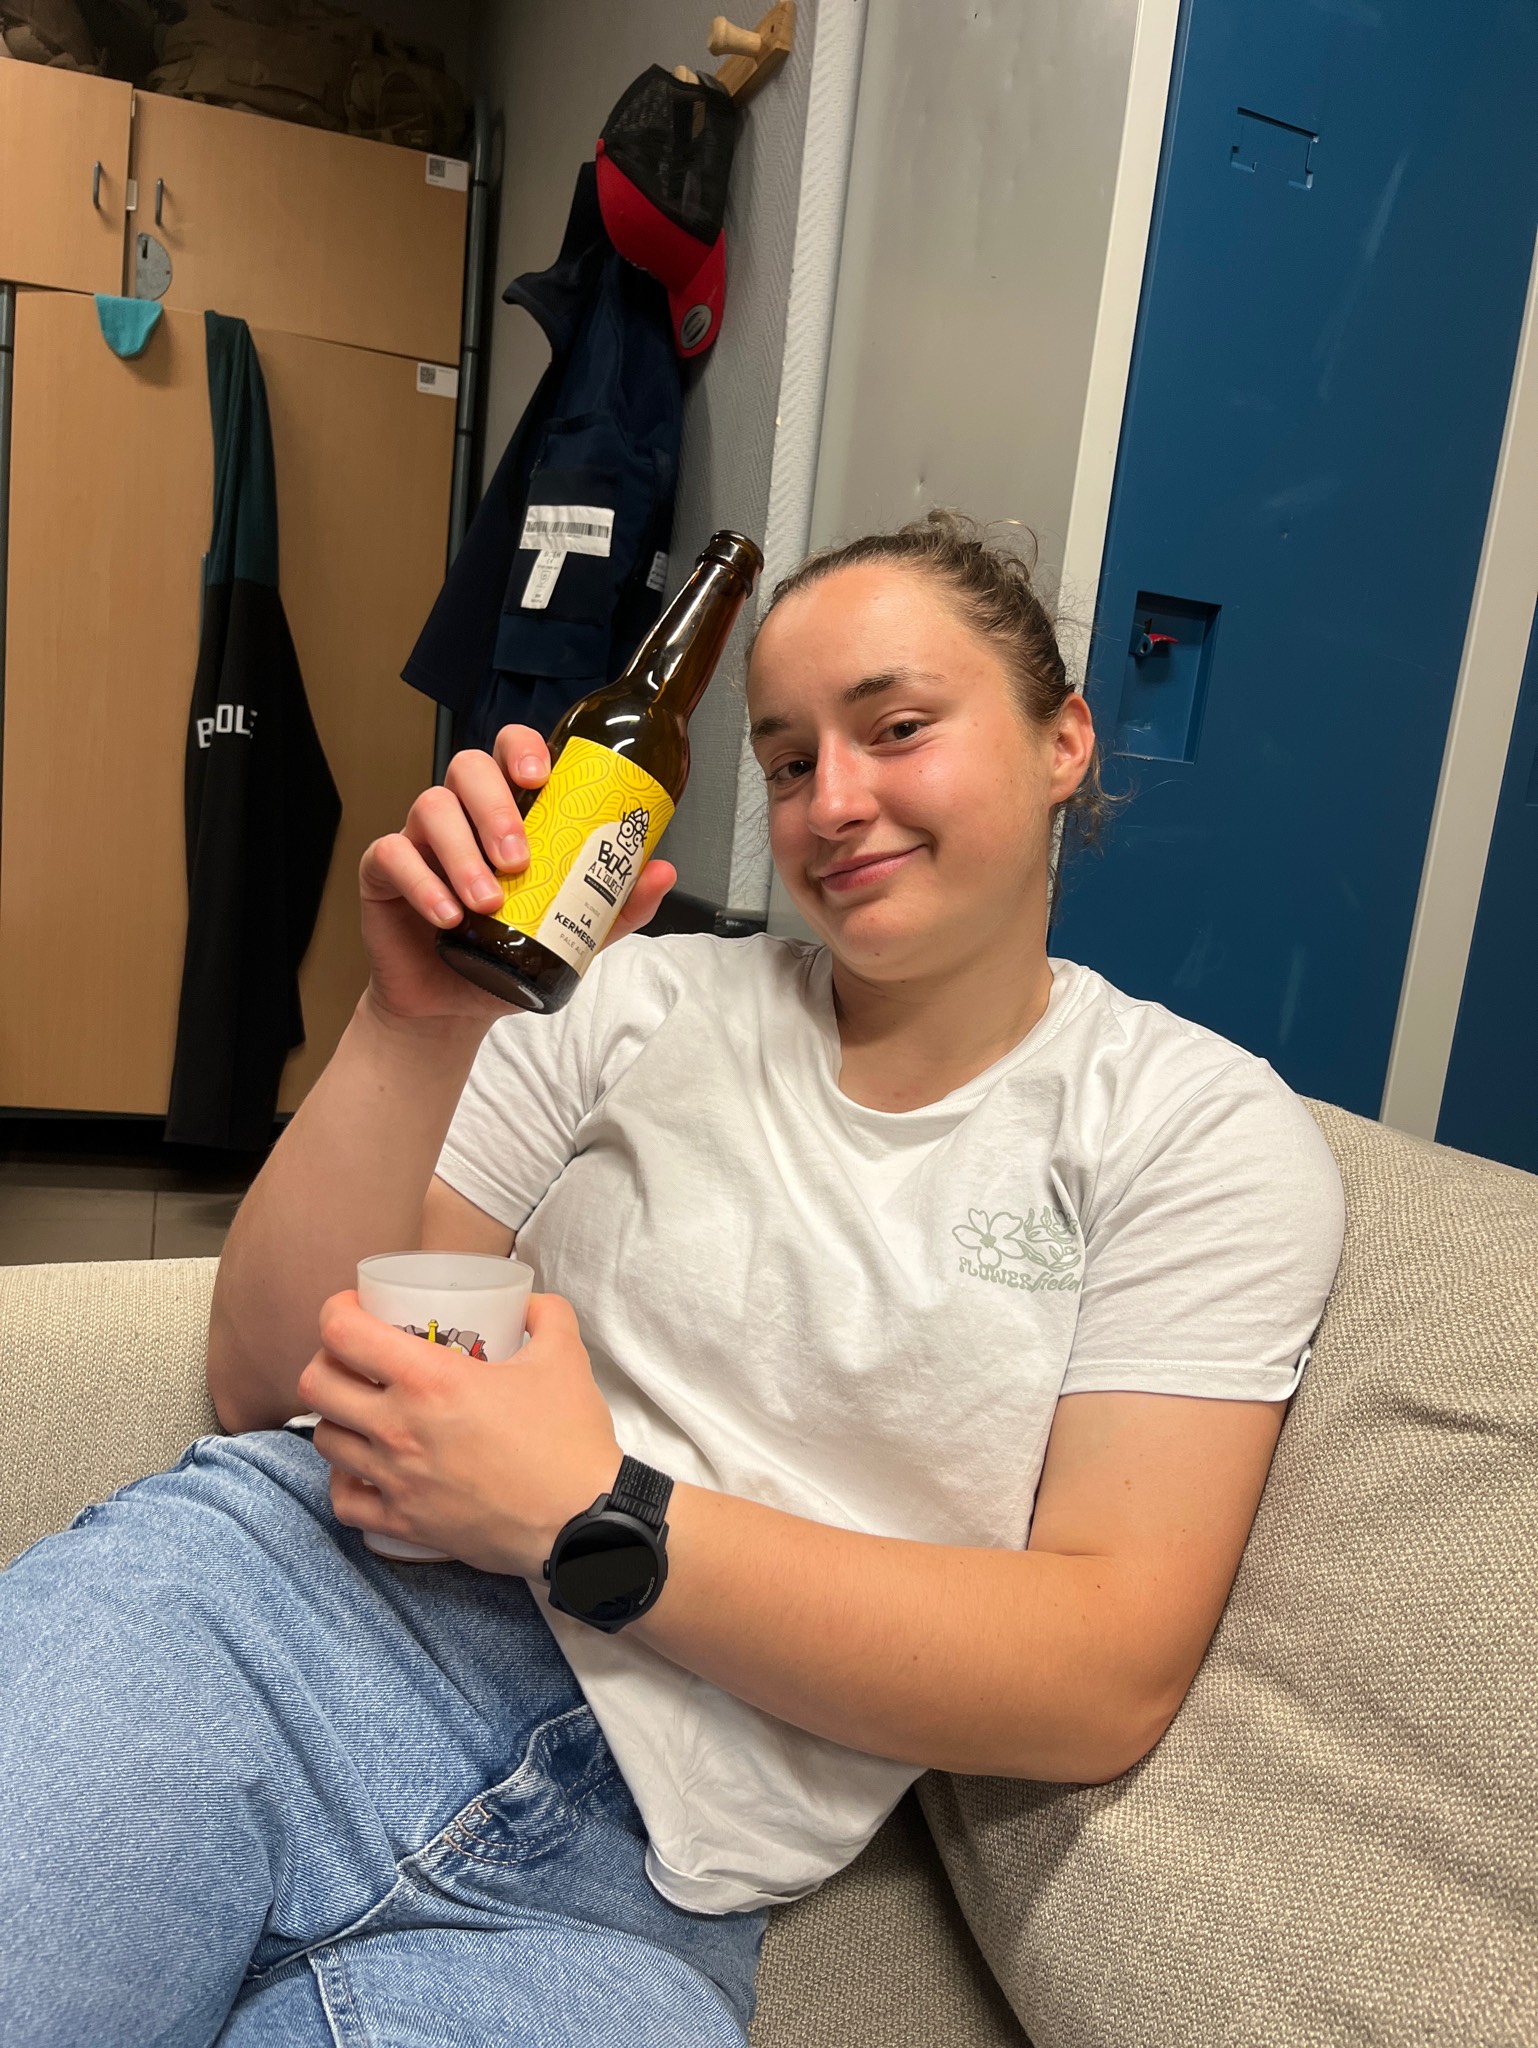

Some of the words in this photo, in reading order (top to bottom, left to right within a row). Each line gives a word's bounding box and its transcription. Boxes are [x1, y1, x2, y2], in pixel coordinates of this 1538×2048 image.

[598, 840, 632, 887] BOCK
[554, 911, 597, 952] KERMESSE
[580, 913, 592, 929] LA
[560, 933, 576, 949] PALE
